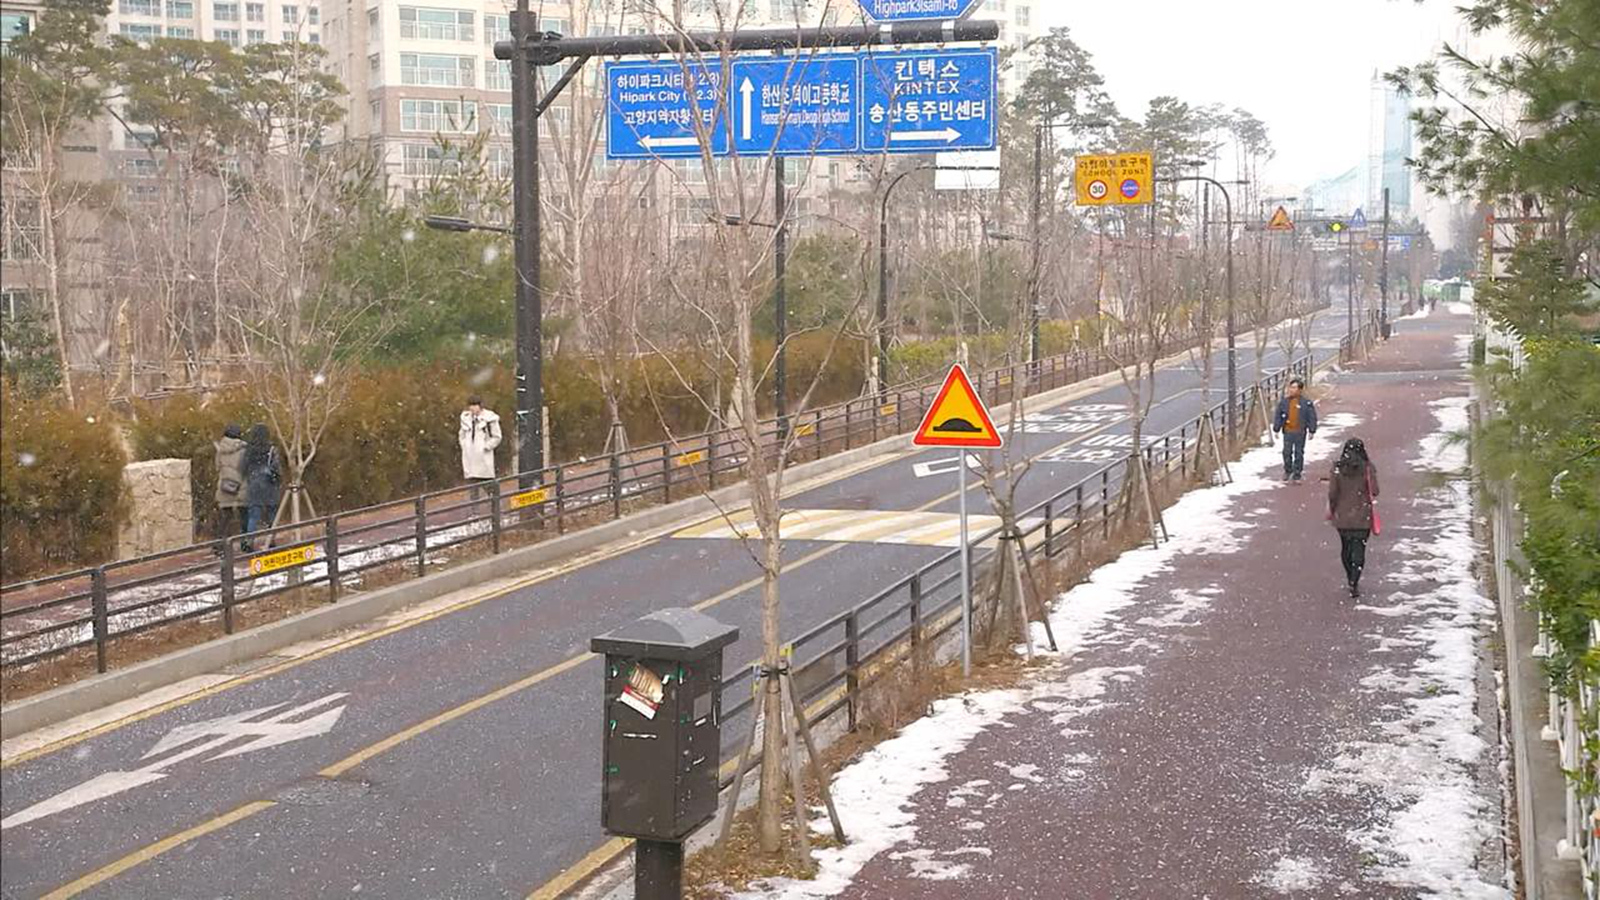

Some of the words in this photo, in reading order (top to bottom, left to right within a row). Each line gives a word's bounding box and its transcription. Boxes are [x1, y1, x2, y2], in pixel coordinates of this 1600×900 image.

[894, 80, 960, 95] KINTEX
[620, 92, 656, 104] Hipark
[658, 90, 680, 104] City
[624, 107, 713, 125] 고양지역자활터
[1092, 185, 1104, 194] 30
